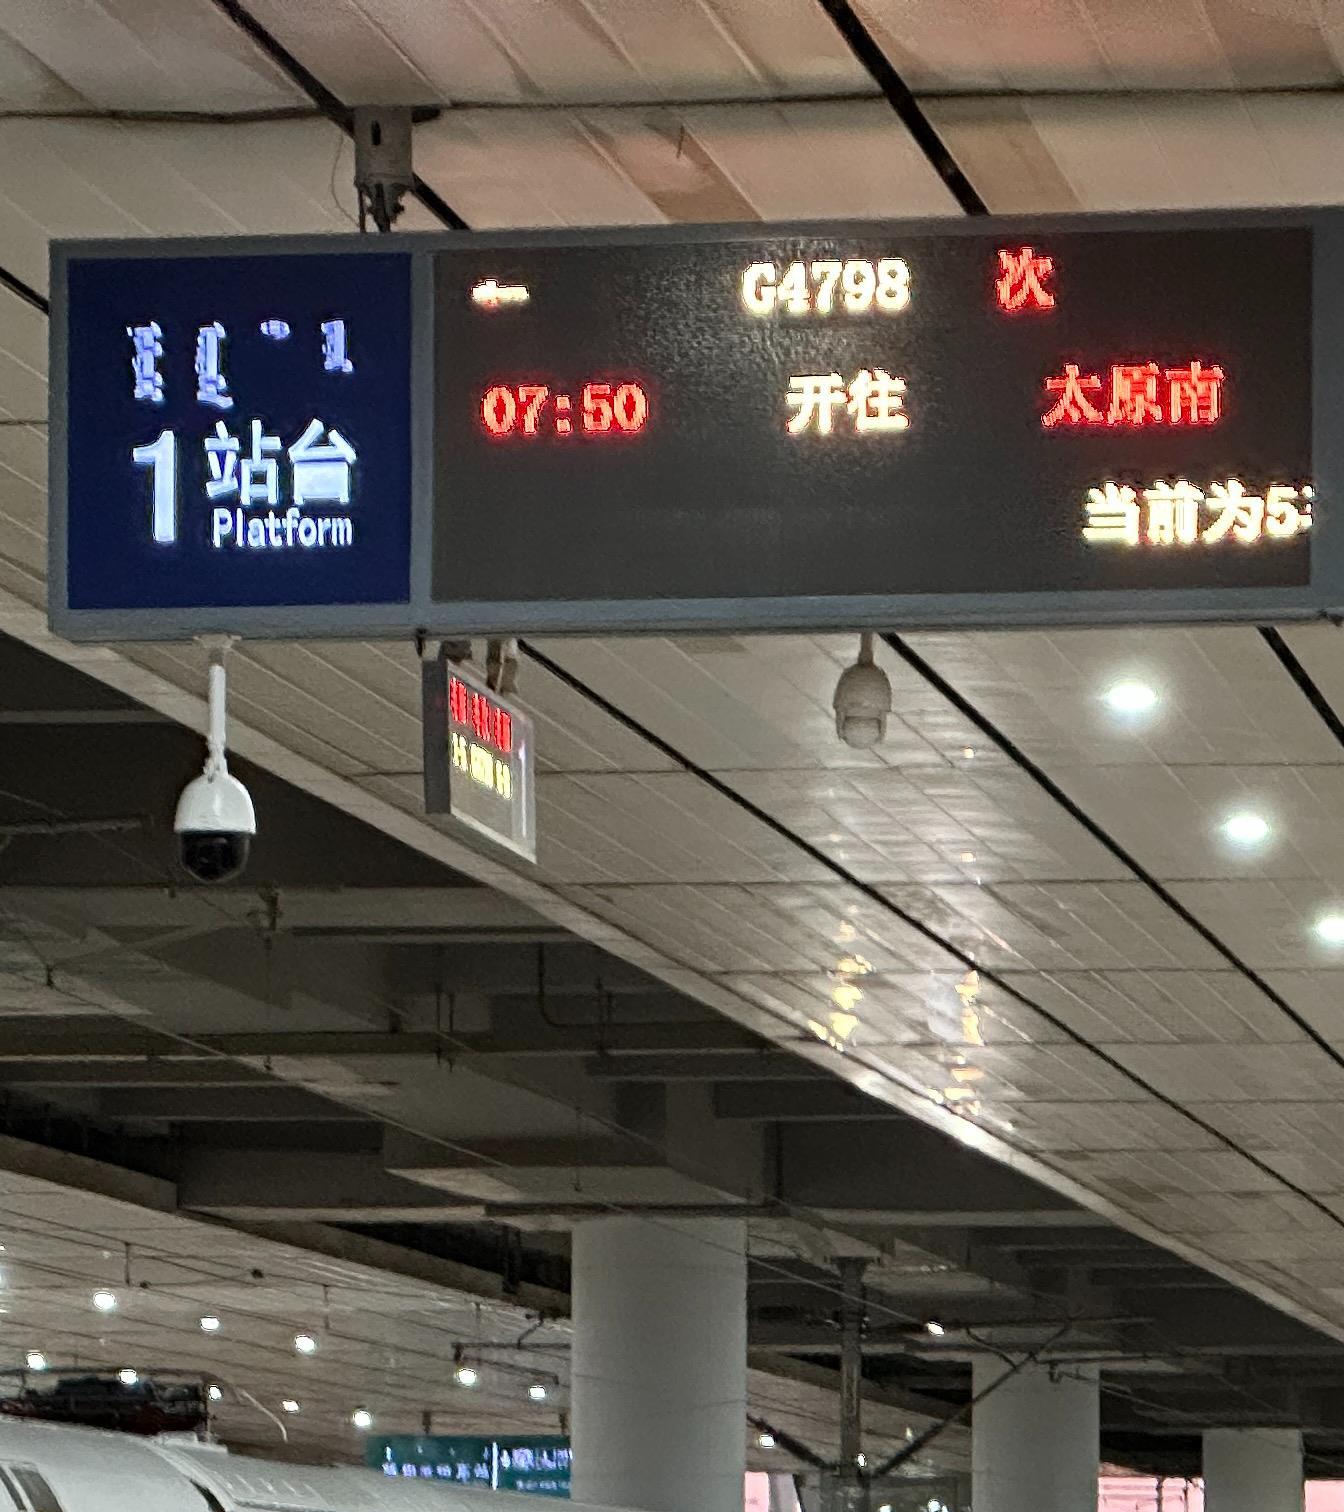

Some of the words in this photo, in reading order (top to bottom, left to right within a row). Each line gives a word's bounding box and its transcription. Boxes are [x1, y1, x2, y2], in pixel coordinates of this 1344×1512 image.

[741, 257, 911, 314] G4798
[995, 247, 1055, 310] 次
[479, 382, 649, 435] 07:50
[785, 367, 911, 434] 开往
[1041, 361, 1225, 428] 太原南
[132, 429, 176, 543] 1
[204, 418, 357, 505] 站台
[212, 506, 353, 548] Platform
